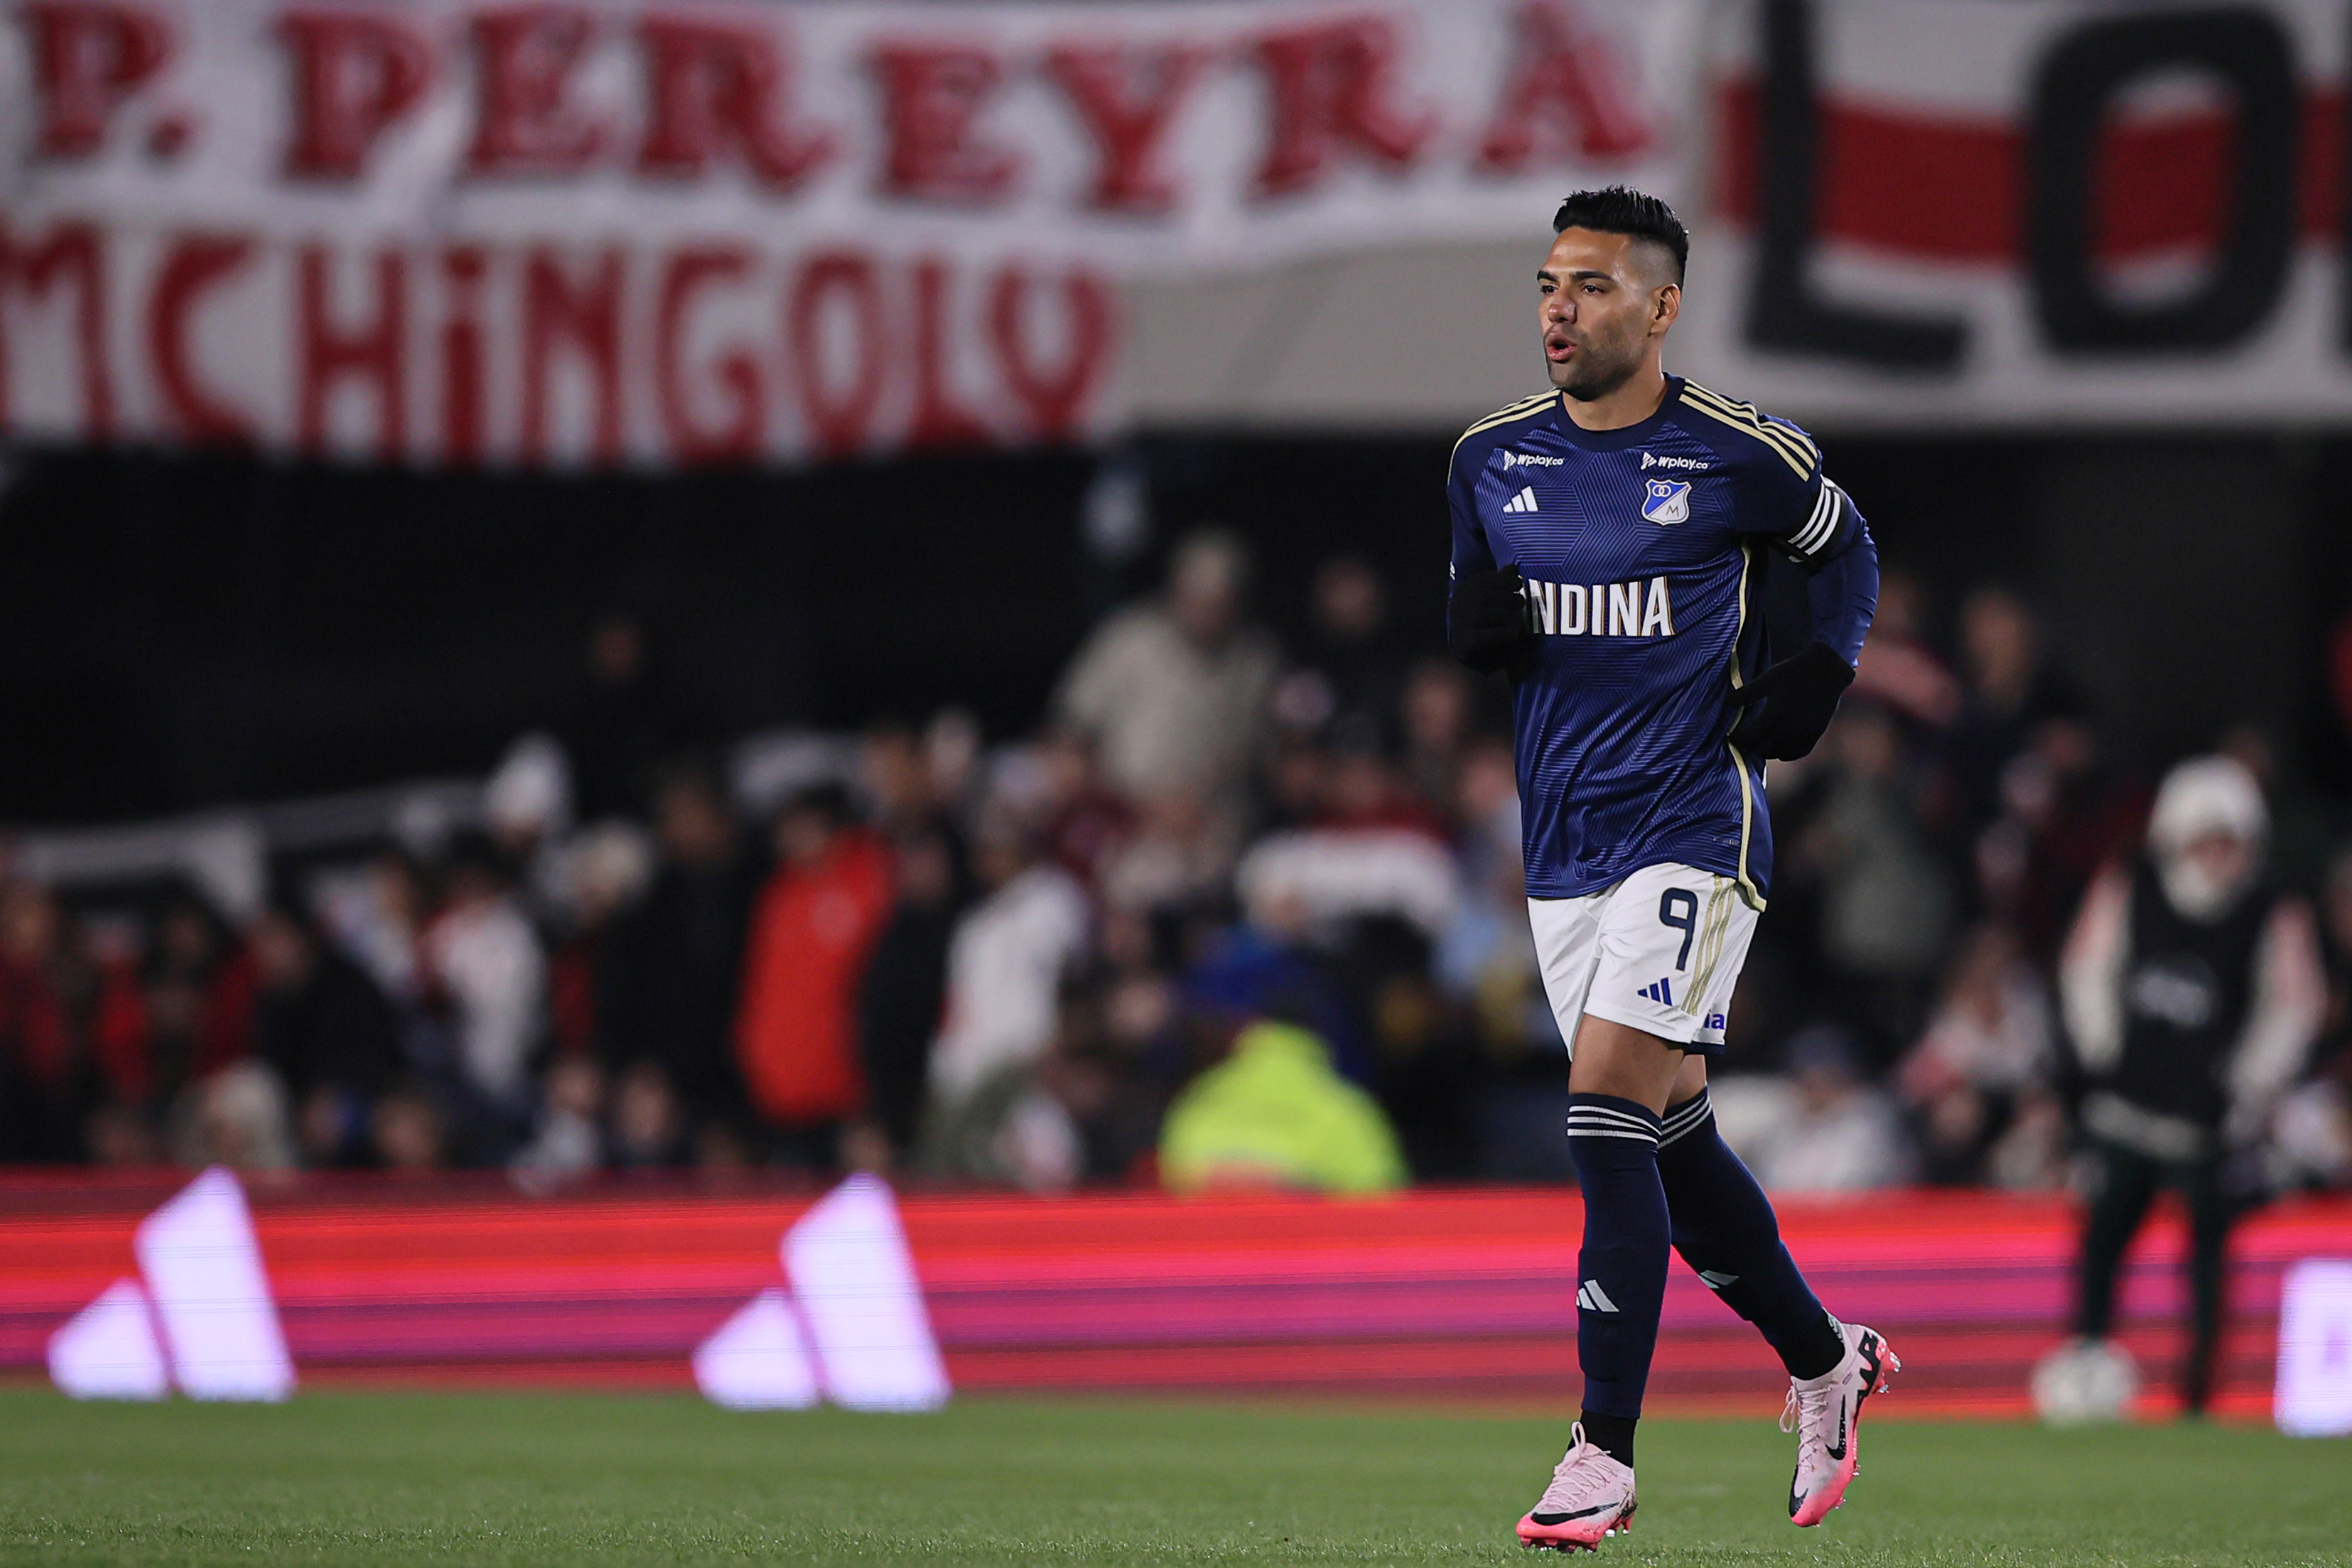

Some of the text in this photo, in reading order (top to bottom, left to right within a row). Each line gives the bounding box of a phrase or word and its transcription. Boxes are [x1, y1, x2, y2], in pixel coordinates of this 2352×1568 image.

[276, 0, 1659, 222] PEREYRA
[1739, 0, 2352, 377] LO
[1517, 453, 1564, 467] Wplay.co
[1658, 455, 1709, 470] Wplay.co
[1514, 575, 1675, 636] NDINA
[1659, 887, 1698, 971] 9
